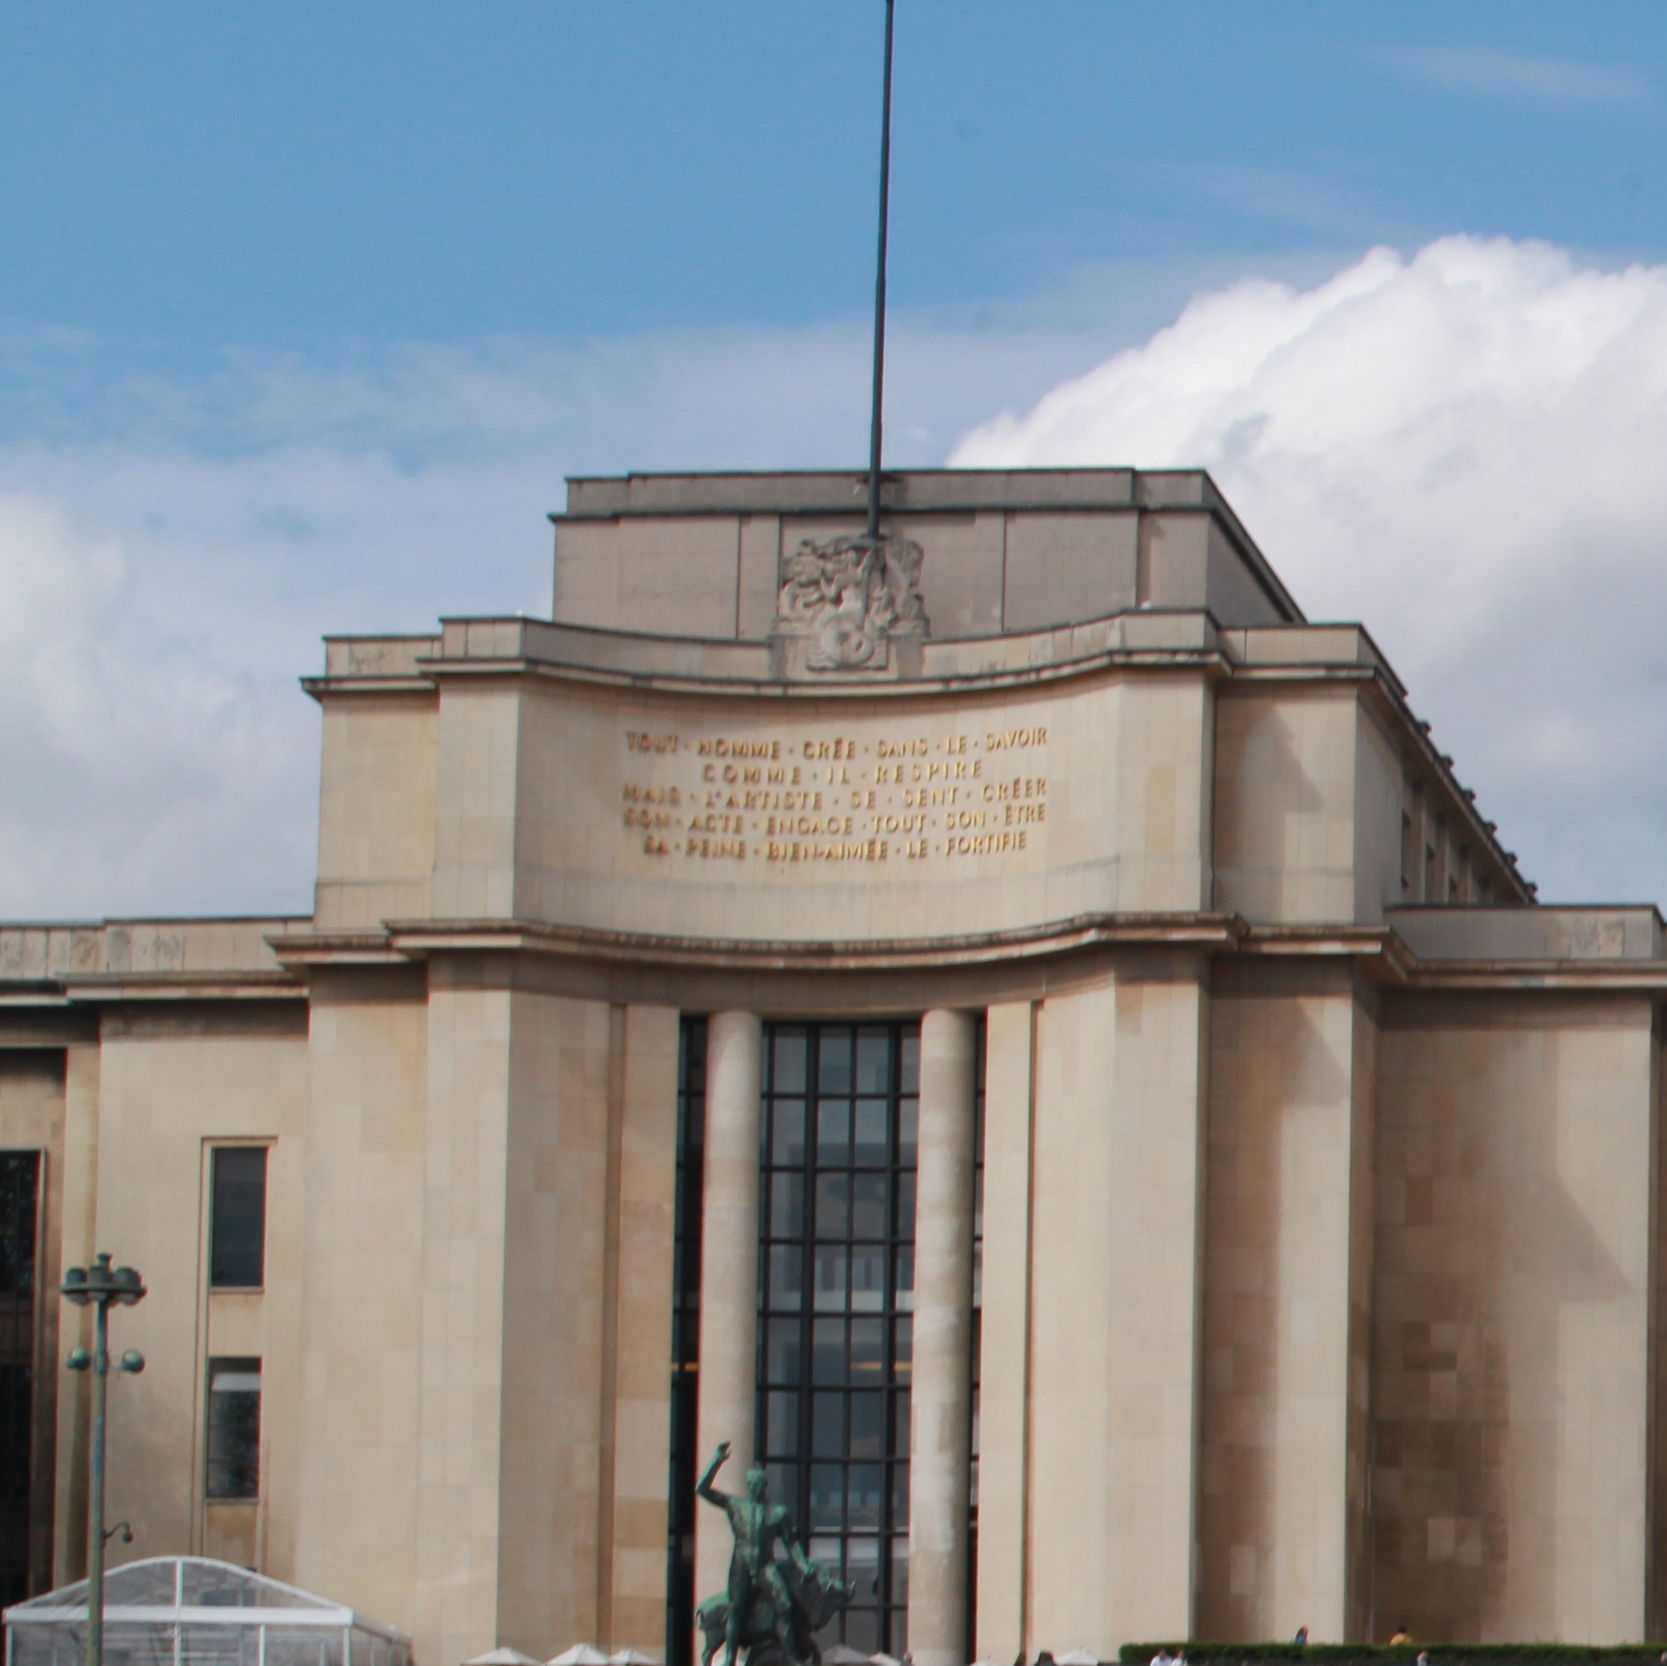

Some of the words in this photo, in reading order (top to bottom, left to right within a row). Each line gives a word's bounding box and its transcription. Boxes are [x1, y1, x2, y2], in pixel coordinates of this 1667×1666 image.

[626, 731, 679, 752] TOUT
[697, 737, 780, 760] HOMME
[803, 737, 855, 760] CRÉE
[878, 737, 928, 758] SANS
[947, 735, 967, 754] LE
[985, 726, 1047, 751] SAVOIR
[703, 763, 801, 785] COMME
[827, 766, 850, 785] IL
[875, 759, 982, 784] RESPIRE
[623, 783, 680, 805] MAIS
[705, 790, 822, 811] L'ARTISTE
[851, 790, 876, 810] SE
[903, 786, 959, 808] SENT
[983, 777, 1046, 803] CRÉER
[624, 807, 669, 829] SON
[688, 813, 744, 834] ACTE
[766, 815, 852, 836] ENGAGE
[872, 813, 927, 834] TOUT
[945, 810, 986, 831] SON
[643, 835, 669, 856] SA
[685, 838, 746, 861] PEINE
[767, 838, 888, 862] BIEN-AIMÉE
[907, 838, 928, 859] LE
[947, 831, 1027, 857] FORTIFIE
